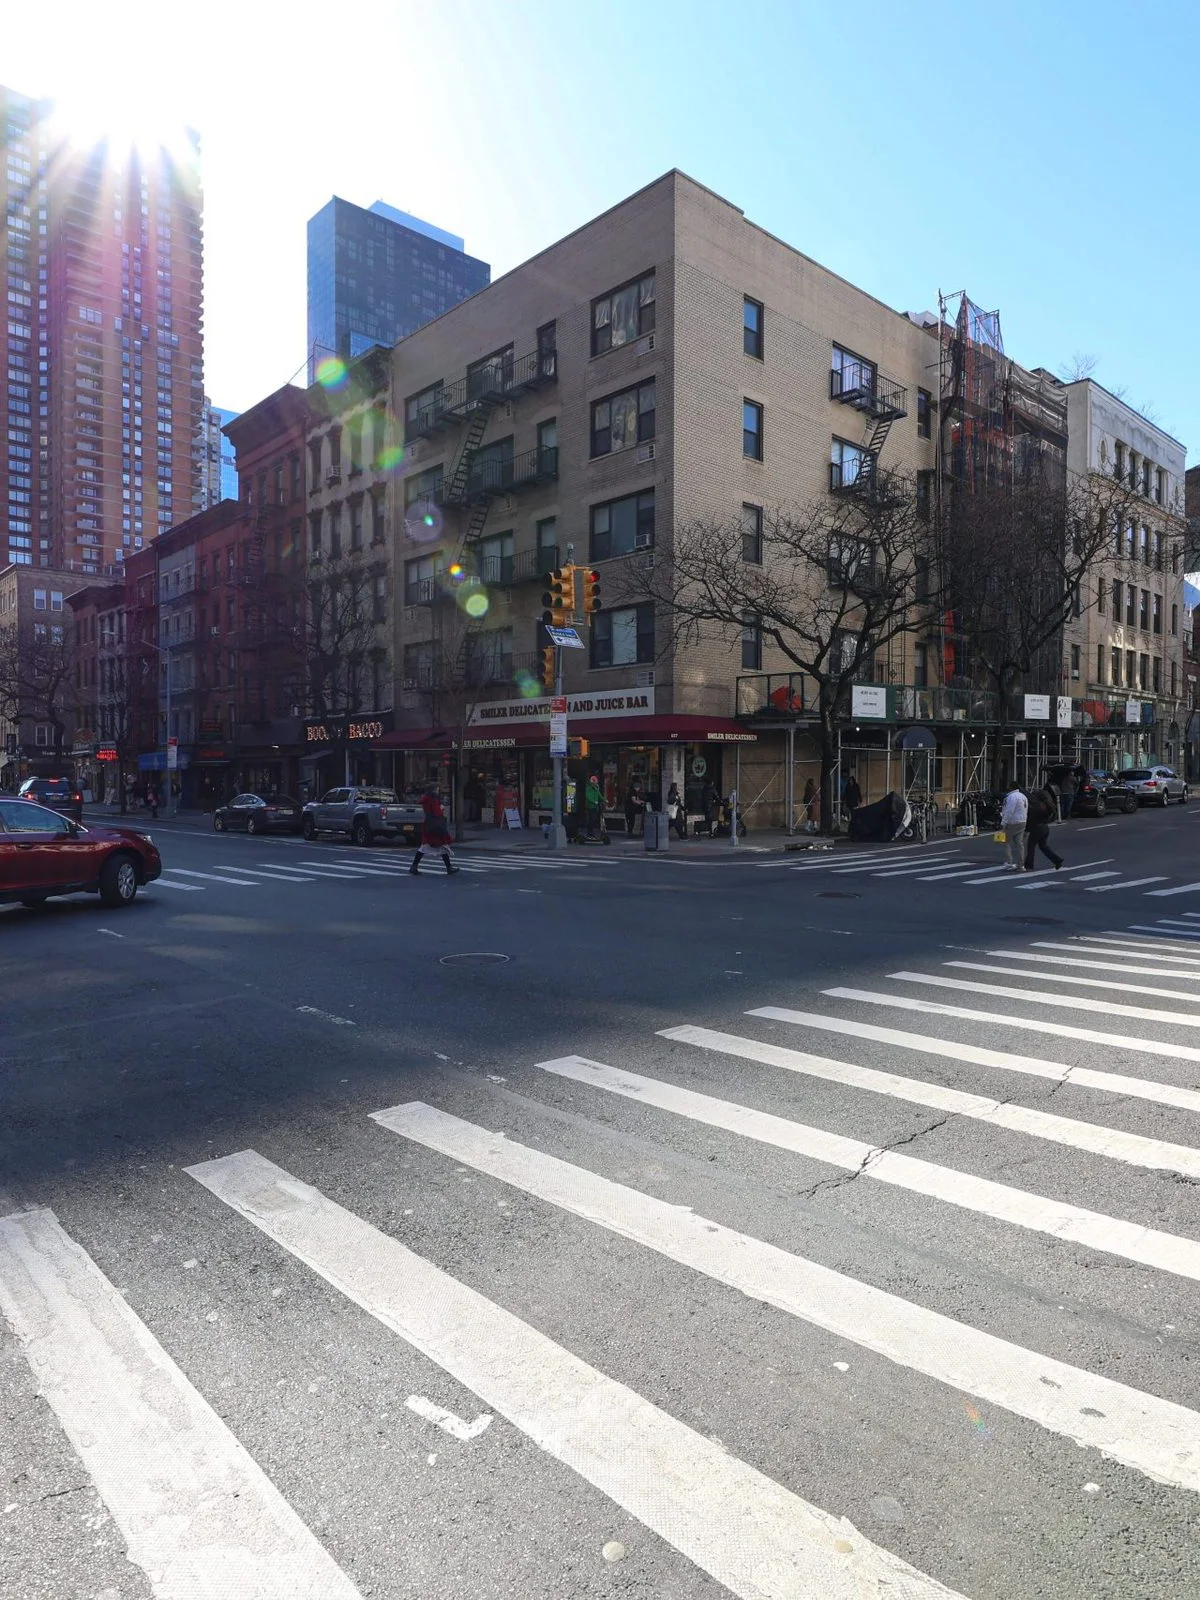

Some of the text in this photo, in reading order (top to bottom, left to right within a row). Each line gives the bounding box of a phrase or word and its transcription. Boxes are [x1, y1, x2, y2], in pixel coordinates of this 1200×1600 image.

[480, 707, 507, 719] SMILER
[573, 700, 593, 713] AND
[595, 697, 625, 711] JUICE
[627, 695, 649, 708] BAR
[349, 721, 382, 739] BACCO
[472, 738, 515, 748] DELICATESSEN
